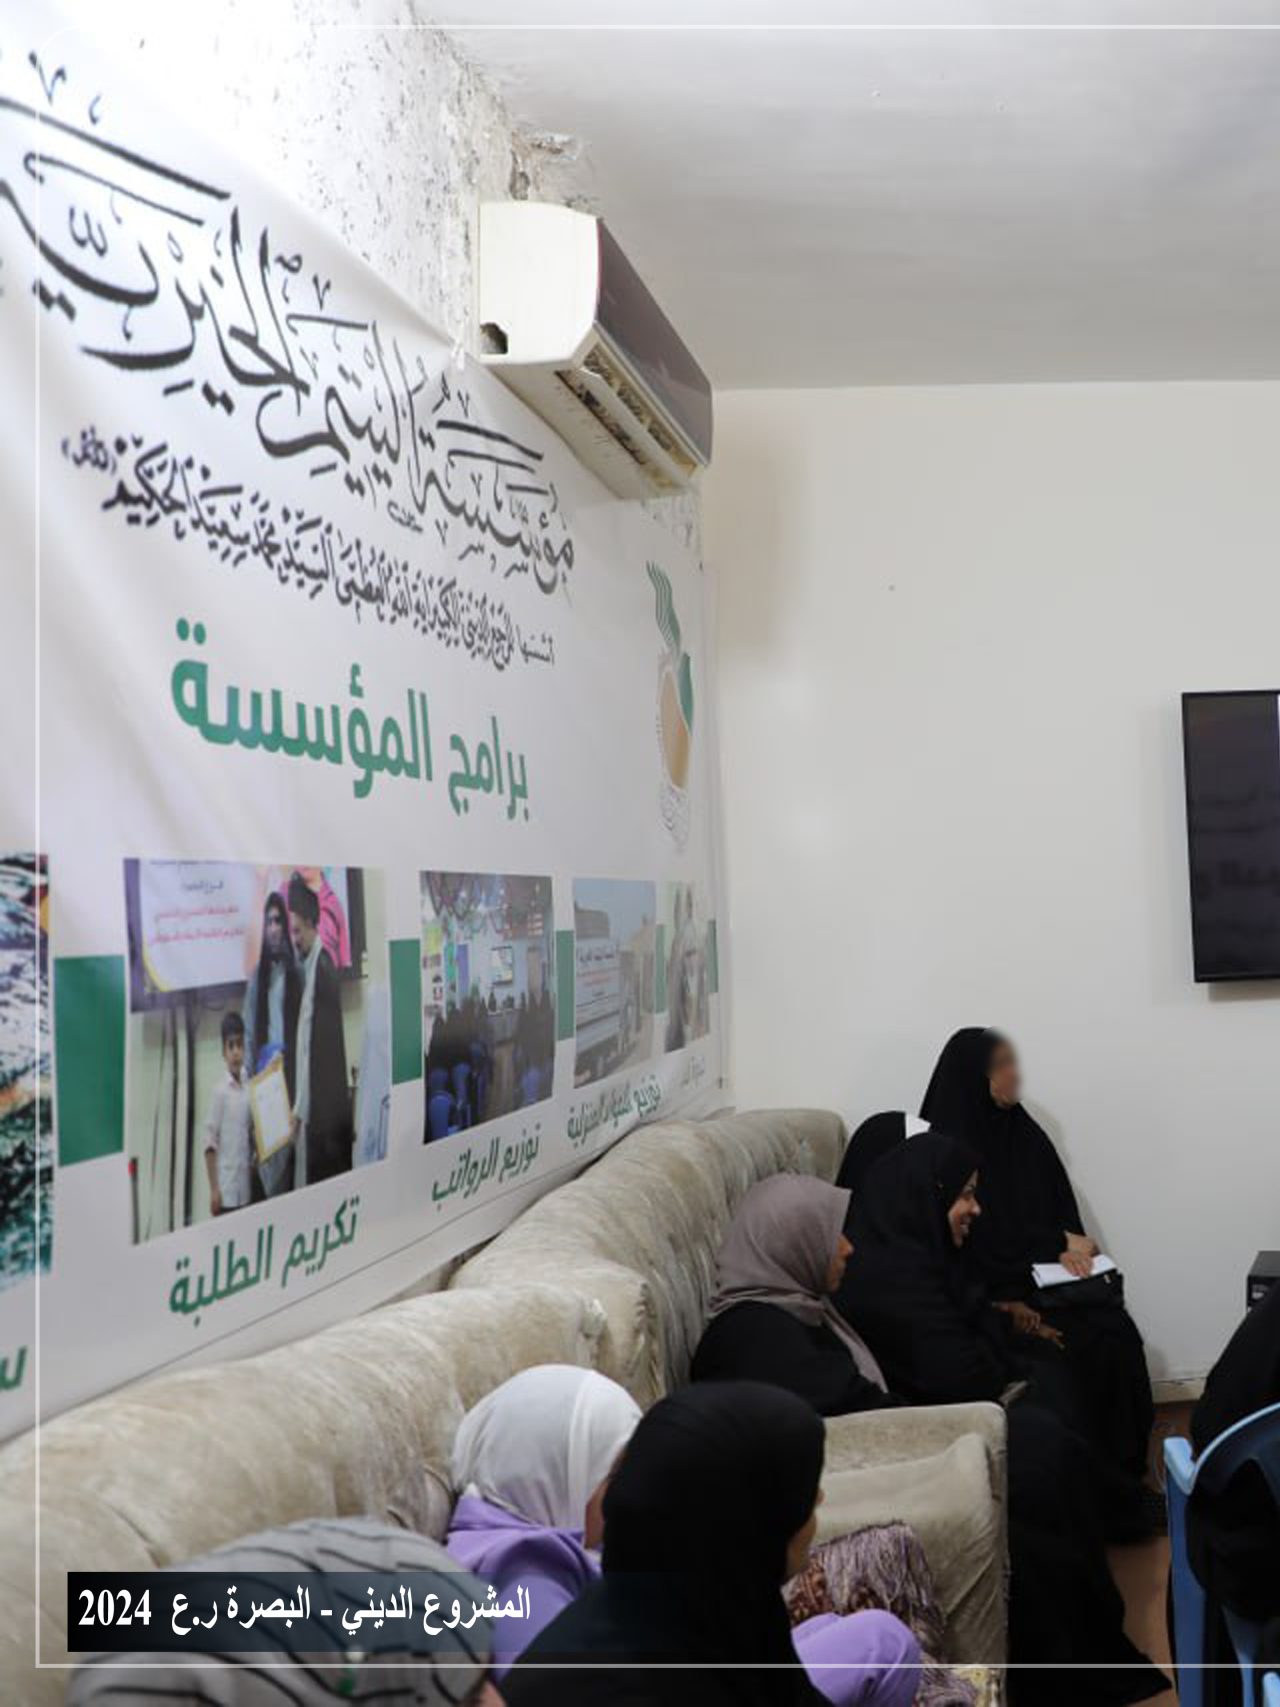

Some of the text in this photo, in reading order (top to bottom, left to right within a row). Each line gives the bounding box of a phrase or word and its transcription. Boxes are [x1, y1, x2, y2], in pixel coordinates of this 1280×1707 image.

[171, 617, 433, 799] المؤسسة
[448, 715, 529, 822] برامج
[431, 1122, 541, 1211] توزيع الرواتب
[168, 1195, 360, 1328] تكريم الطلبة
